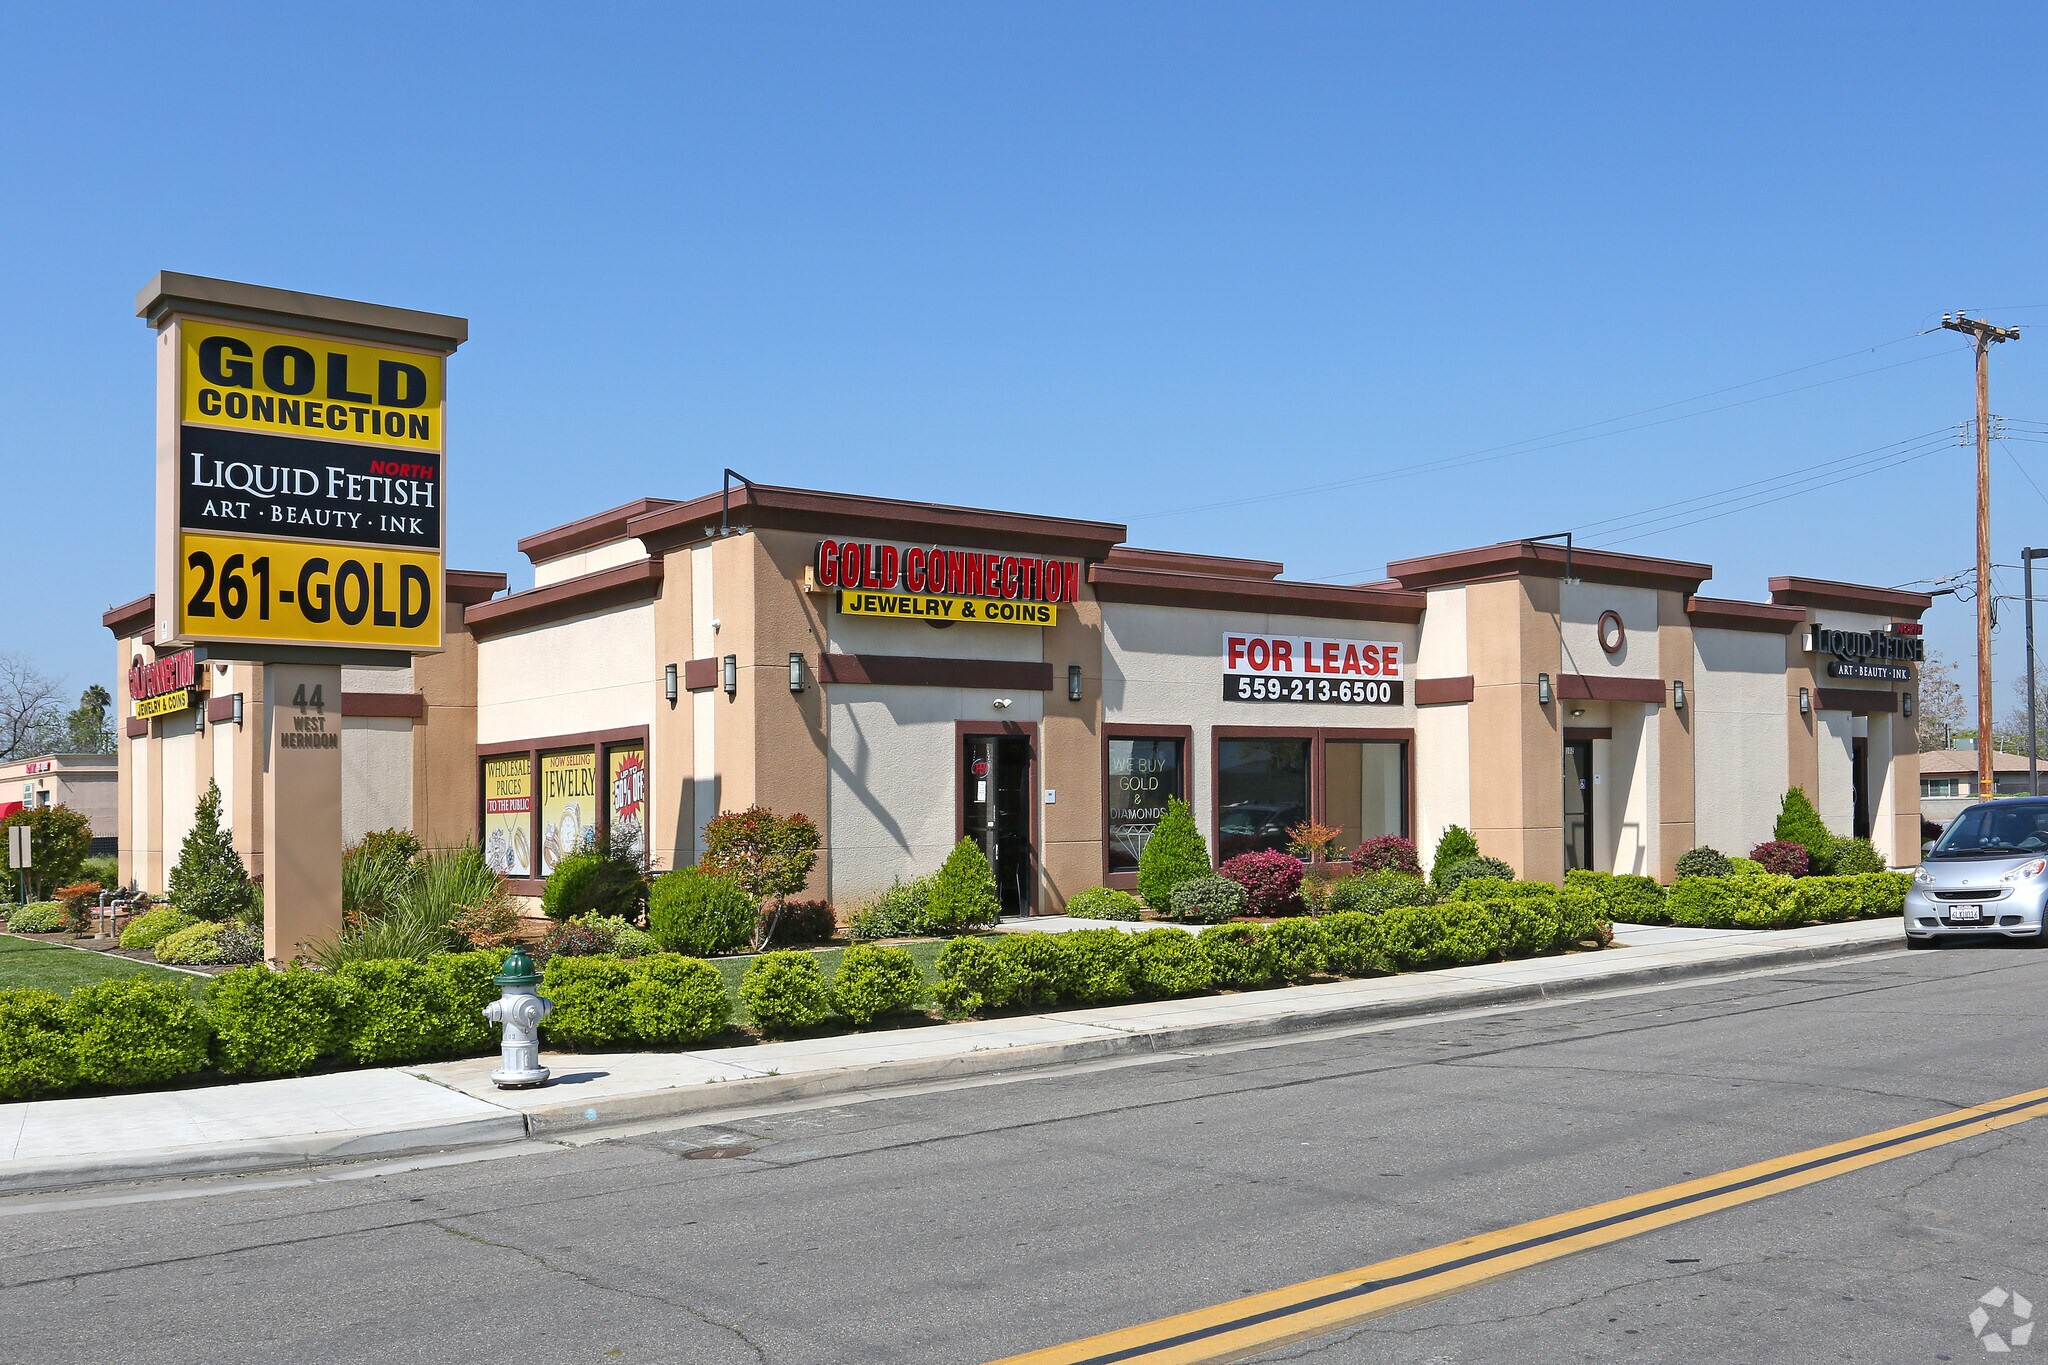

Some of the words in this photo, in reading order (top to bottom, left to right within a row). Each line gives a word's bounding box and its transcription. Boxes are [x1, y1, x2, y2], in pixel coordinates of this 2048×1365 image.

[198, 335, 427, 409] GOLD
[198, 388, 429, 440] CONNECTION
[191, 452, 320, 499] LIQUID
[326, 466, 434, 508] FETISH
[370, 459, 434, 480] NORTH
[202, 499, 250, 519] ART
[271, 505, 362, 529] BEAUTY
[380, 515, 424, 535] INK
[814, 539, 899, 589] GOLD
[906, 547, 1079, 603] CONNECTION
[187, 550, 431, 629] 261-GOLD
[850, 594, 953, 616] JEWELRY
[961, 603, 976, 618] &
[985, 603, 1050, 622] COINS
[1896, 623, 1923, 635] NORTH
[1811, 623, 1874, 661] LIQUID
[1871, 629, 1924, 661] FETISH
[1228, 637, 1292, 672] FOR
[1304, 641, 1398, 676] LEASE
[1838, 664, 1853, 676] ART
[1859, 666, 1888, 678] BEAUTY
[292, 683, 325, 716] 44
[1238, 677, 1391, 703] 559-213-6500
[137, 700, 161, 717] JEWELRY
[168, 694, 186, 710] COINS
[293, 716, 326, 732] WEST
[281, 732, 338, 750] HERNDON
[550, 756, 565, 768] NOW
[566, 754, 591, 767] SELLING
[620, 770, 628, 779] UP
[629, 766, 638, 775] TO
[1113, 757, 1134, 771] WE
[1138, 758, 1166, 773] BUY
[496, 778, 522, 796] PRICES
[544, 768, 595, 806] JEWELRY
[1120, 776, 1159, 791] GOLD
[488, 800, 497, 811] TO
[497, 799, 510, 811] THE
[509, 798, 530, 811] PUBLIC
[1134, 793, 1142, 805] &
